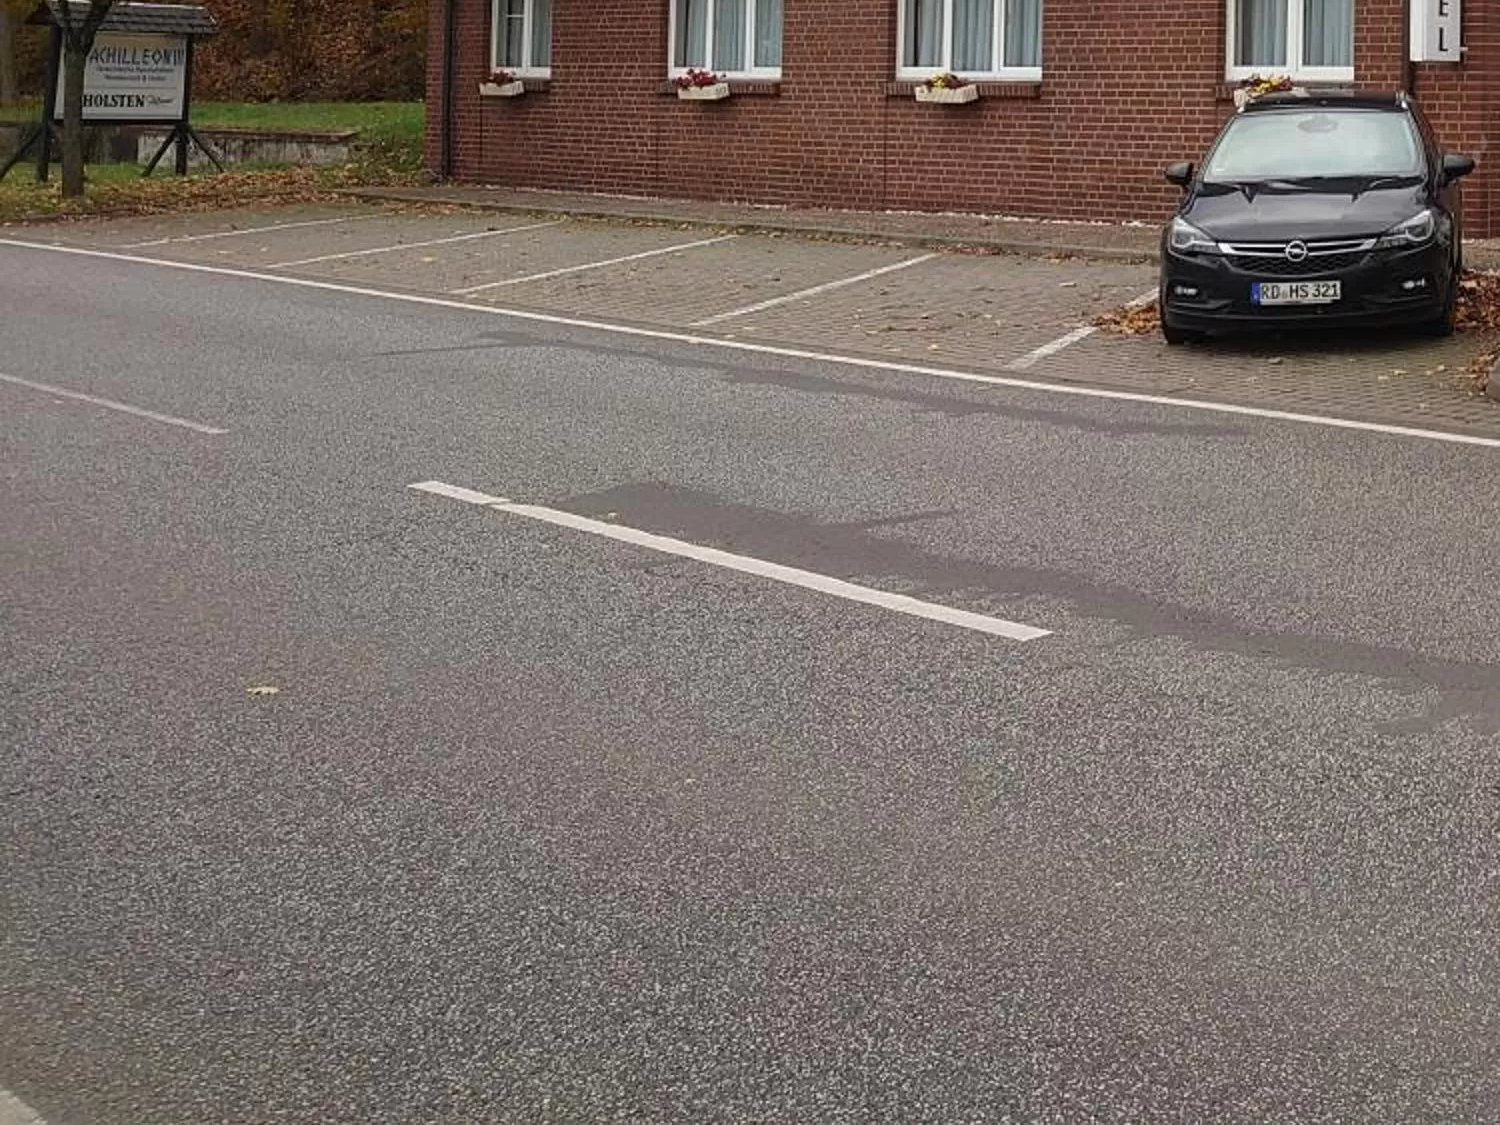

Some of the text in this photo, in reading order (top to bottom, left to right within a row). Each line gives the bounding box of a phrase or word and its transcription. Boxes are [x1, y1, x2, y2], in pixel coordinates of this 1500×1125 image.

[83, 94, 145, 108] HOLSTEN
[1262, 283, 1339, 299] RD HS 321
